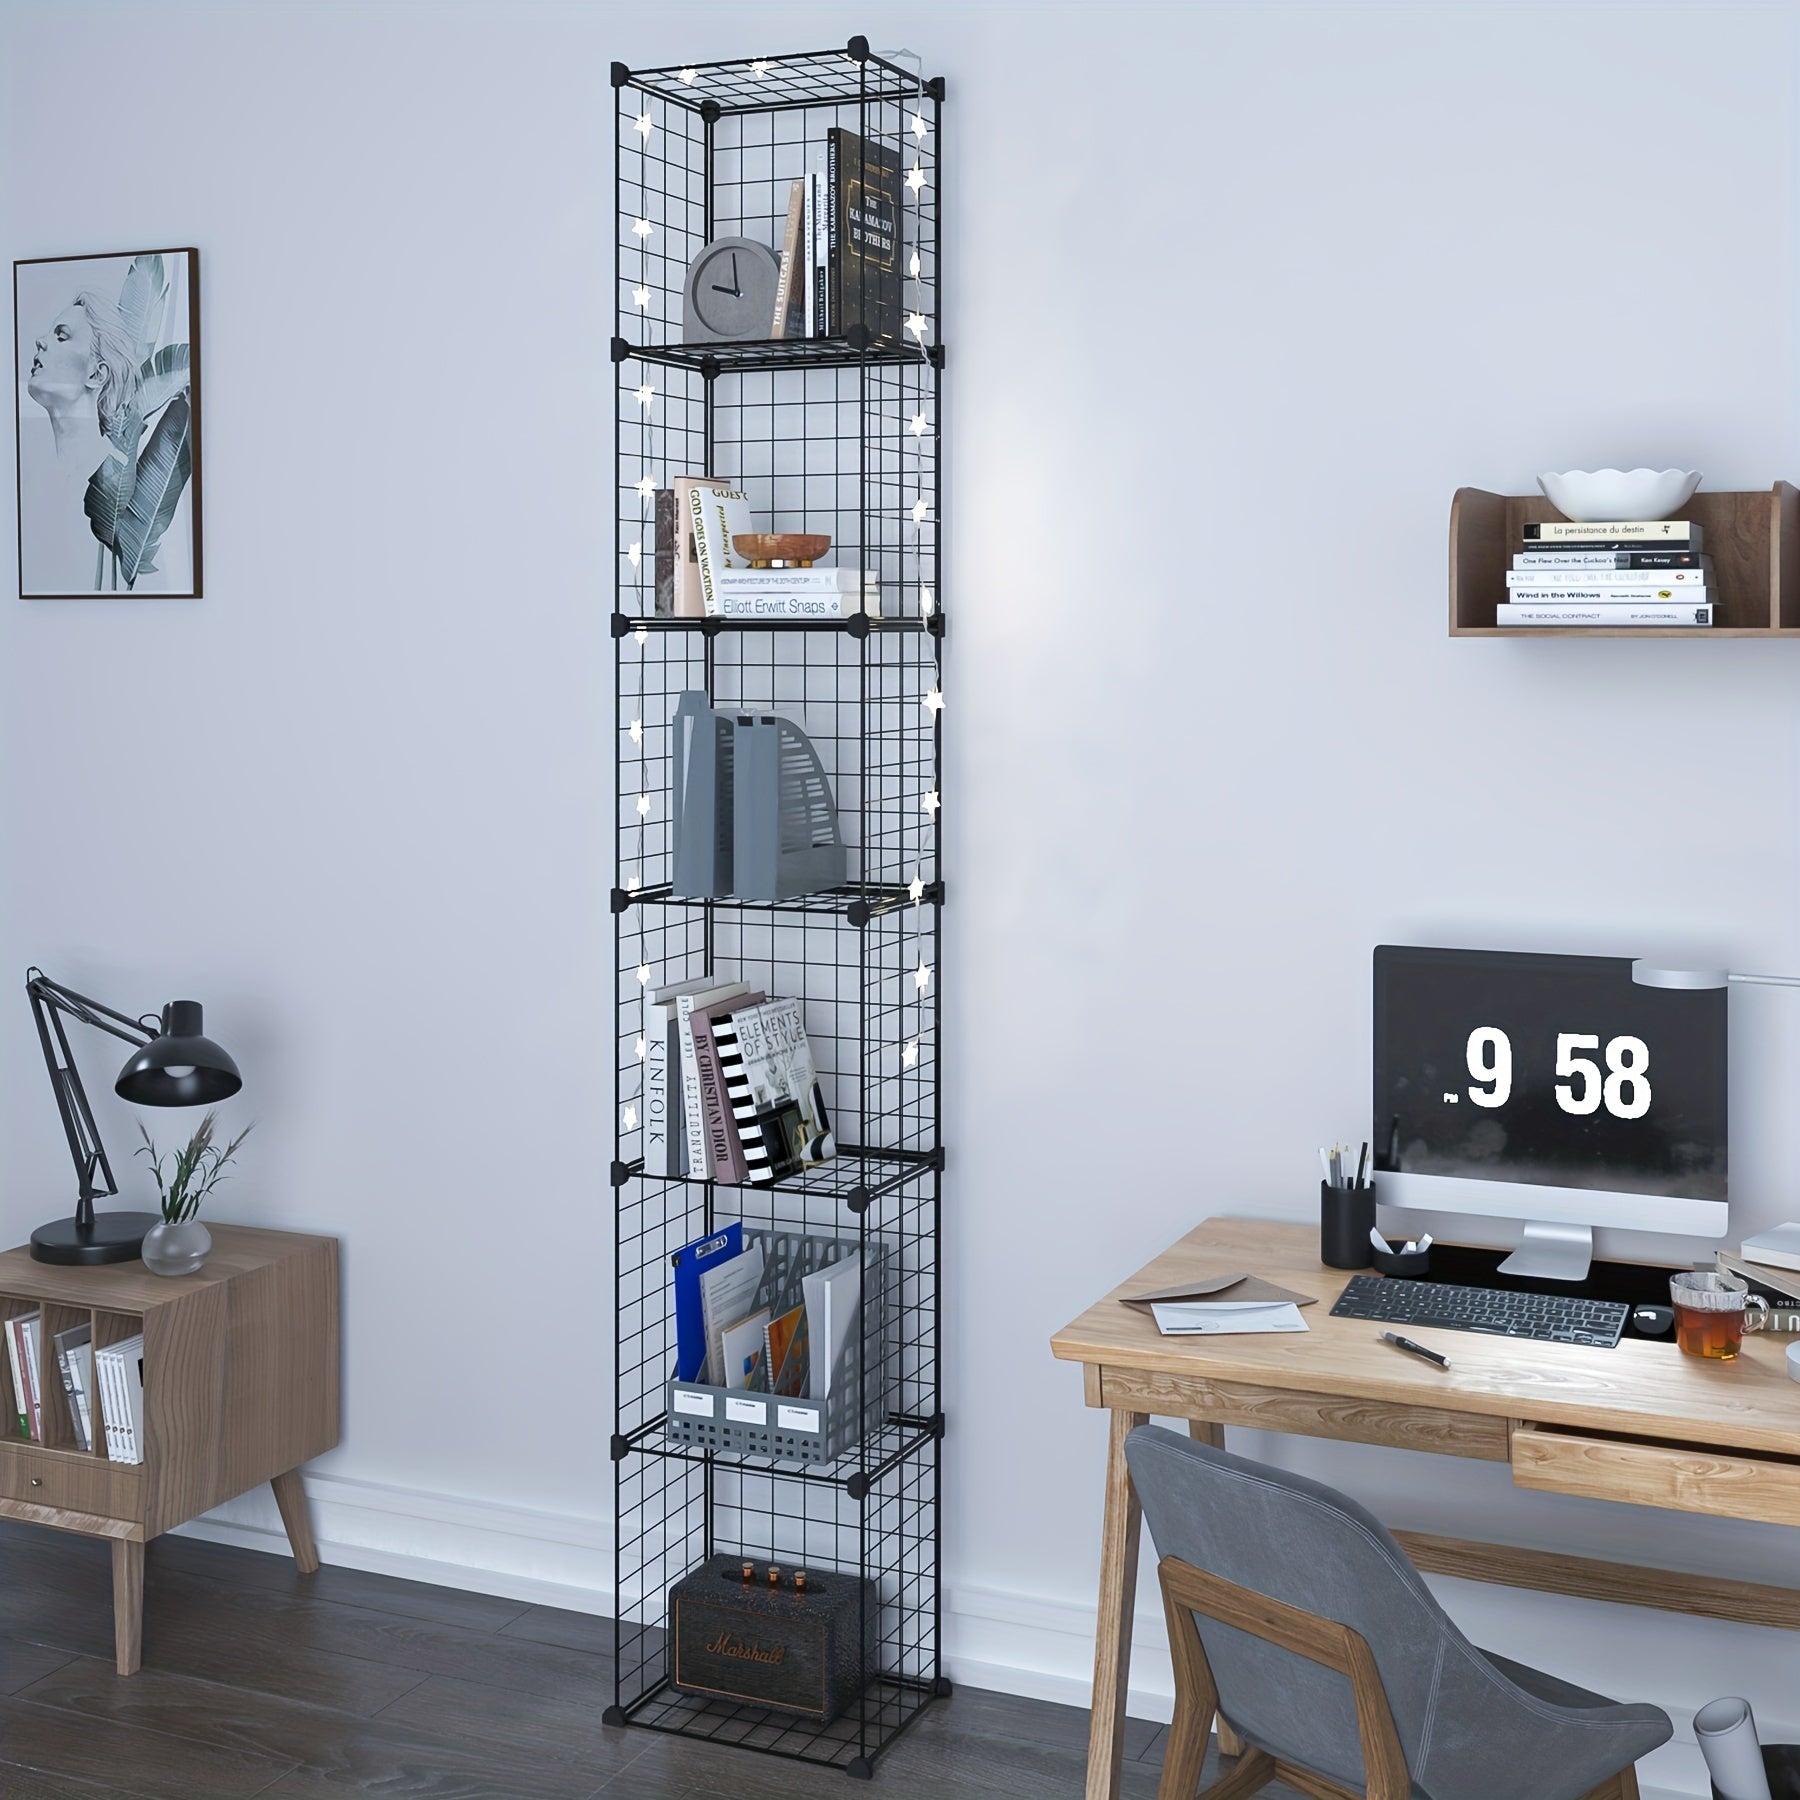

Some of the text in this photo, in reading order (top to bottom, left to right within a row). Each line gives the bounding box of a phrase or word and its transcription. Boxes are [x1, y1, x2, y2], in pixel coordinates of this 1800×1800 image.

[865, 196, 878, 210] THE
[773, 250, 790, 326] THE SUITCASE
[690, 489, 714, 602] GOD GOES ON VACATION
[1554, 526, 1562, 534] La
[1564, 526, 1608, 536] persistance
[724, 598, 825, 615] Elliott Erwitt Snaps
[740, 1010, 800, 1040] ELEMENTS
[744, 1040, 760, 1057] OF
[765, 1026, 804, 1050] STYLE
[650, 1040, 664, 1144] KINFOLK
[694, 1035, 728, 1162] BY CHRISTIAN DIOR
[1466, 1026, 1652, 1120] 9 58
[686, 1076, 703, 1173] TRANQUILITY
[706, 1632, 785, 1665] Marshall
